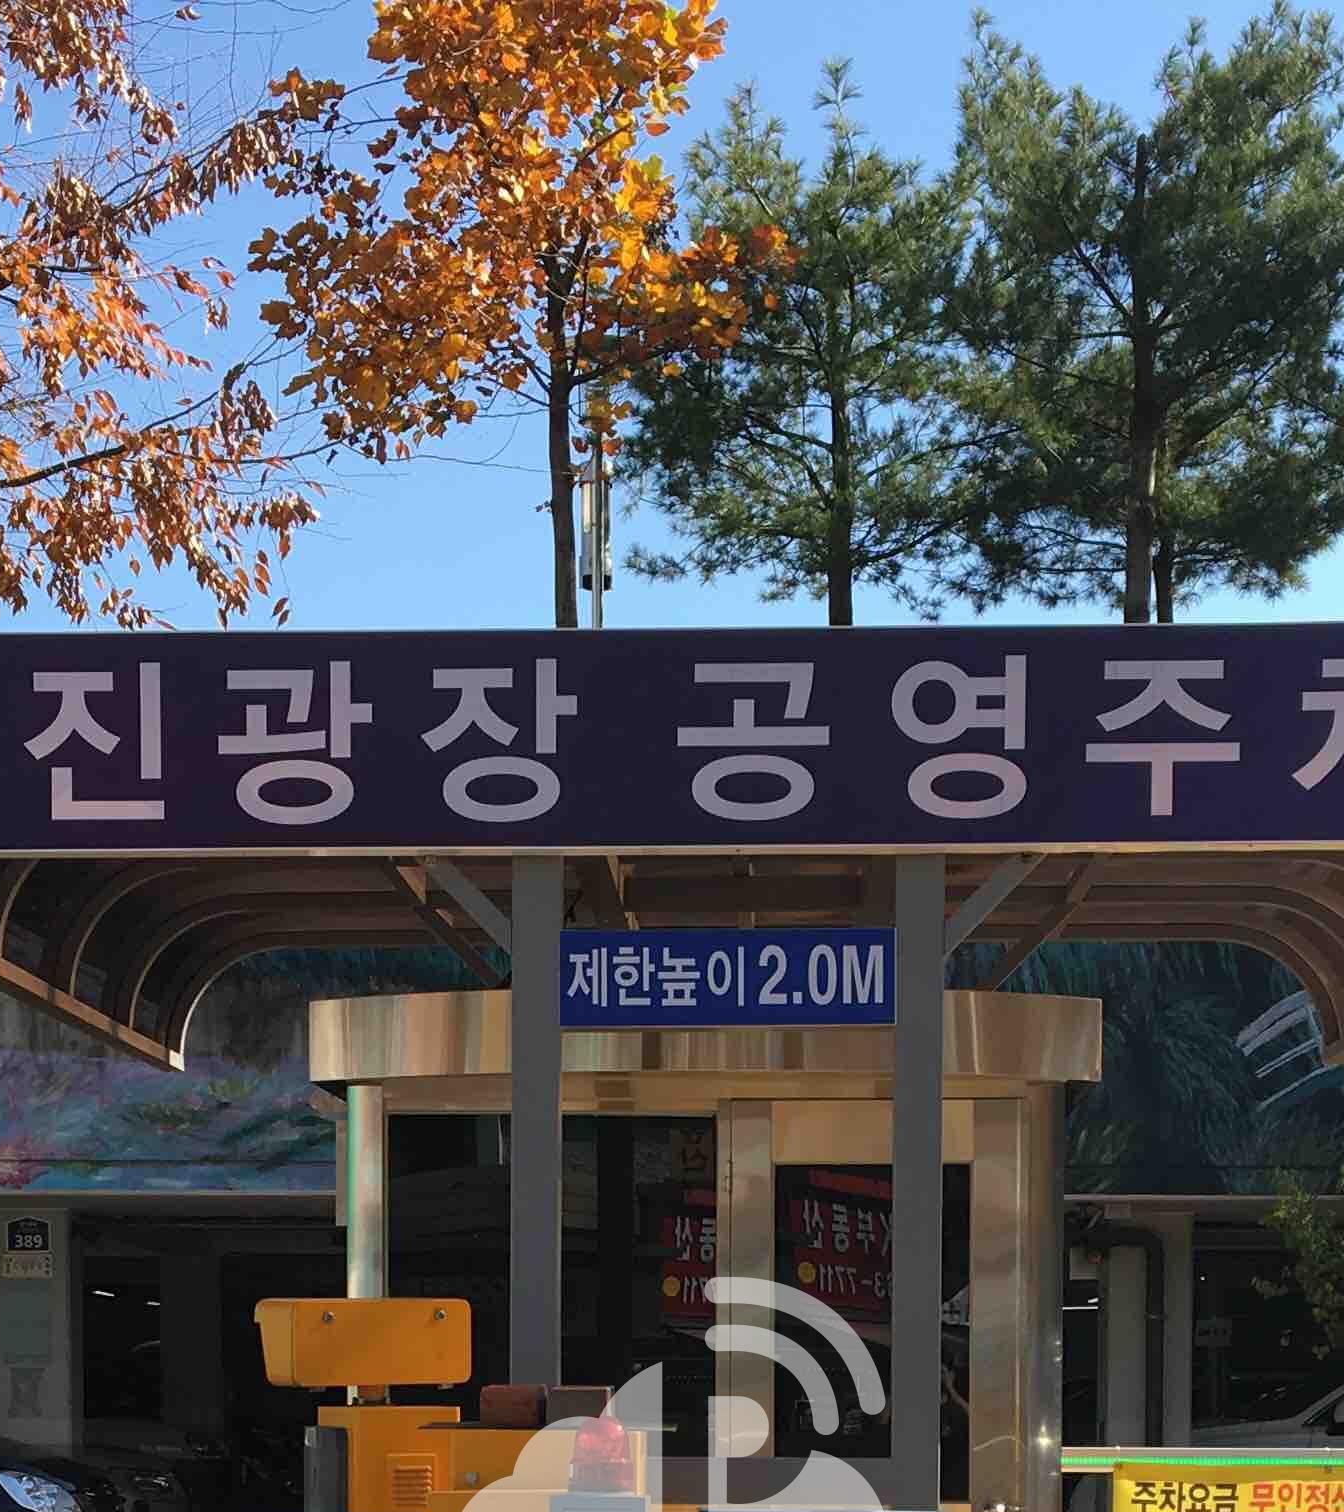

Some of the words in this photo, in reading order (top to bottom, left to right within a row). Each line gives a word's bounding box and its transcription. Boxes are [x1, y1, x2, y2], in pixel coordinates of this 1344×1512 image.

[567, 946, 745, 1008] 제한높이
[758, 944, 885, 1006] 2.0M
[14, 1233, 43, 1249] 389
